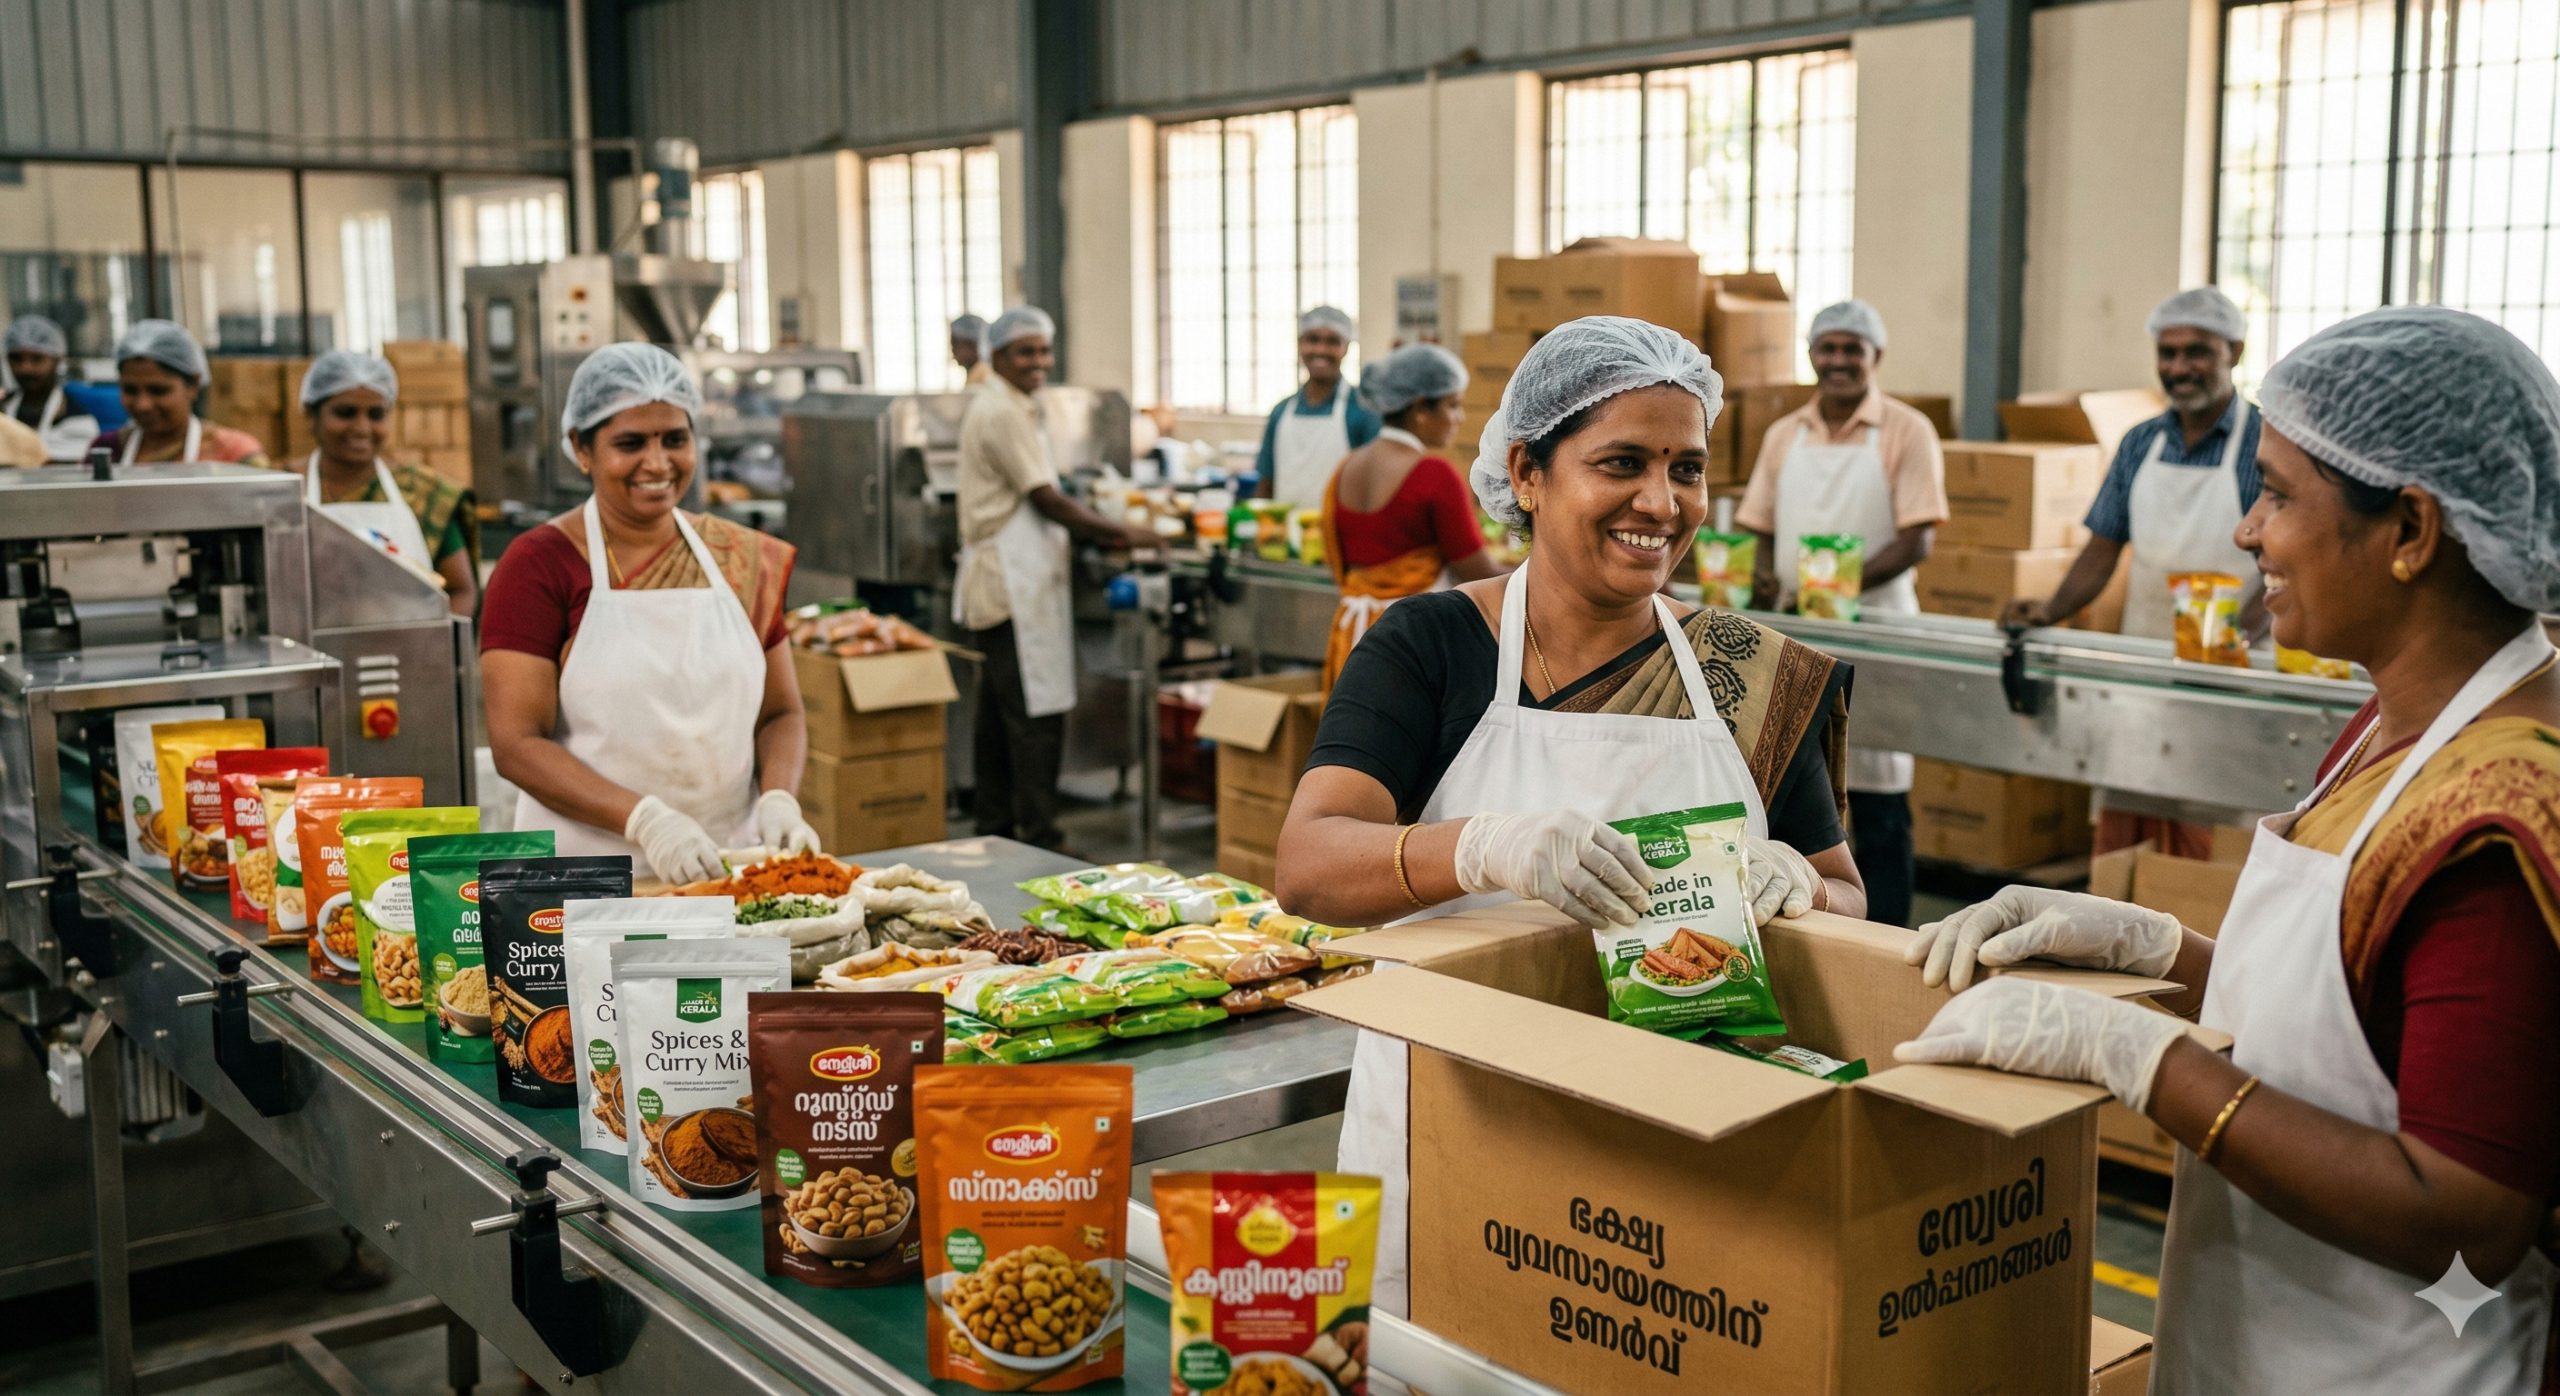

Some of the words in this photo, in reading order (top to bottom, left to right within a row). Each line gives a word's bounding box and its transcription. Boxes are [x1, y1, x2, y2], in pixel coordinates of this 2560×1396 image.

[1643, 847, 1686, 860] KERALA
[1648, 876, 1688, 896] ade
[1692, 873, 1712, 889] in
[506, 960, 560, 980] Curry
[680, 1005, 717, 1014] KERALA
[651, 1030, 723, 1054] Spices
[731, 1029, 747, 1048] &
[645, 1053, 708, 1076] Curry
[1569, 1196, 1665, 1270] ഭക്ഷ്യ
[1484, 1219, 1769, 1349] വ്യവസായത്തിന്
[1550, 1296, 1688, 1377] ഉണർവ്
